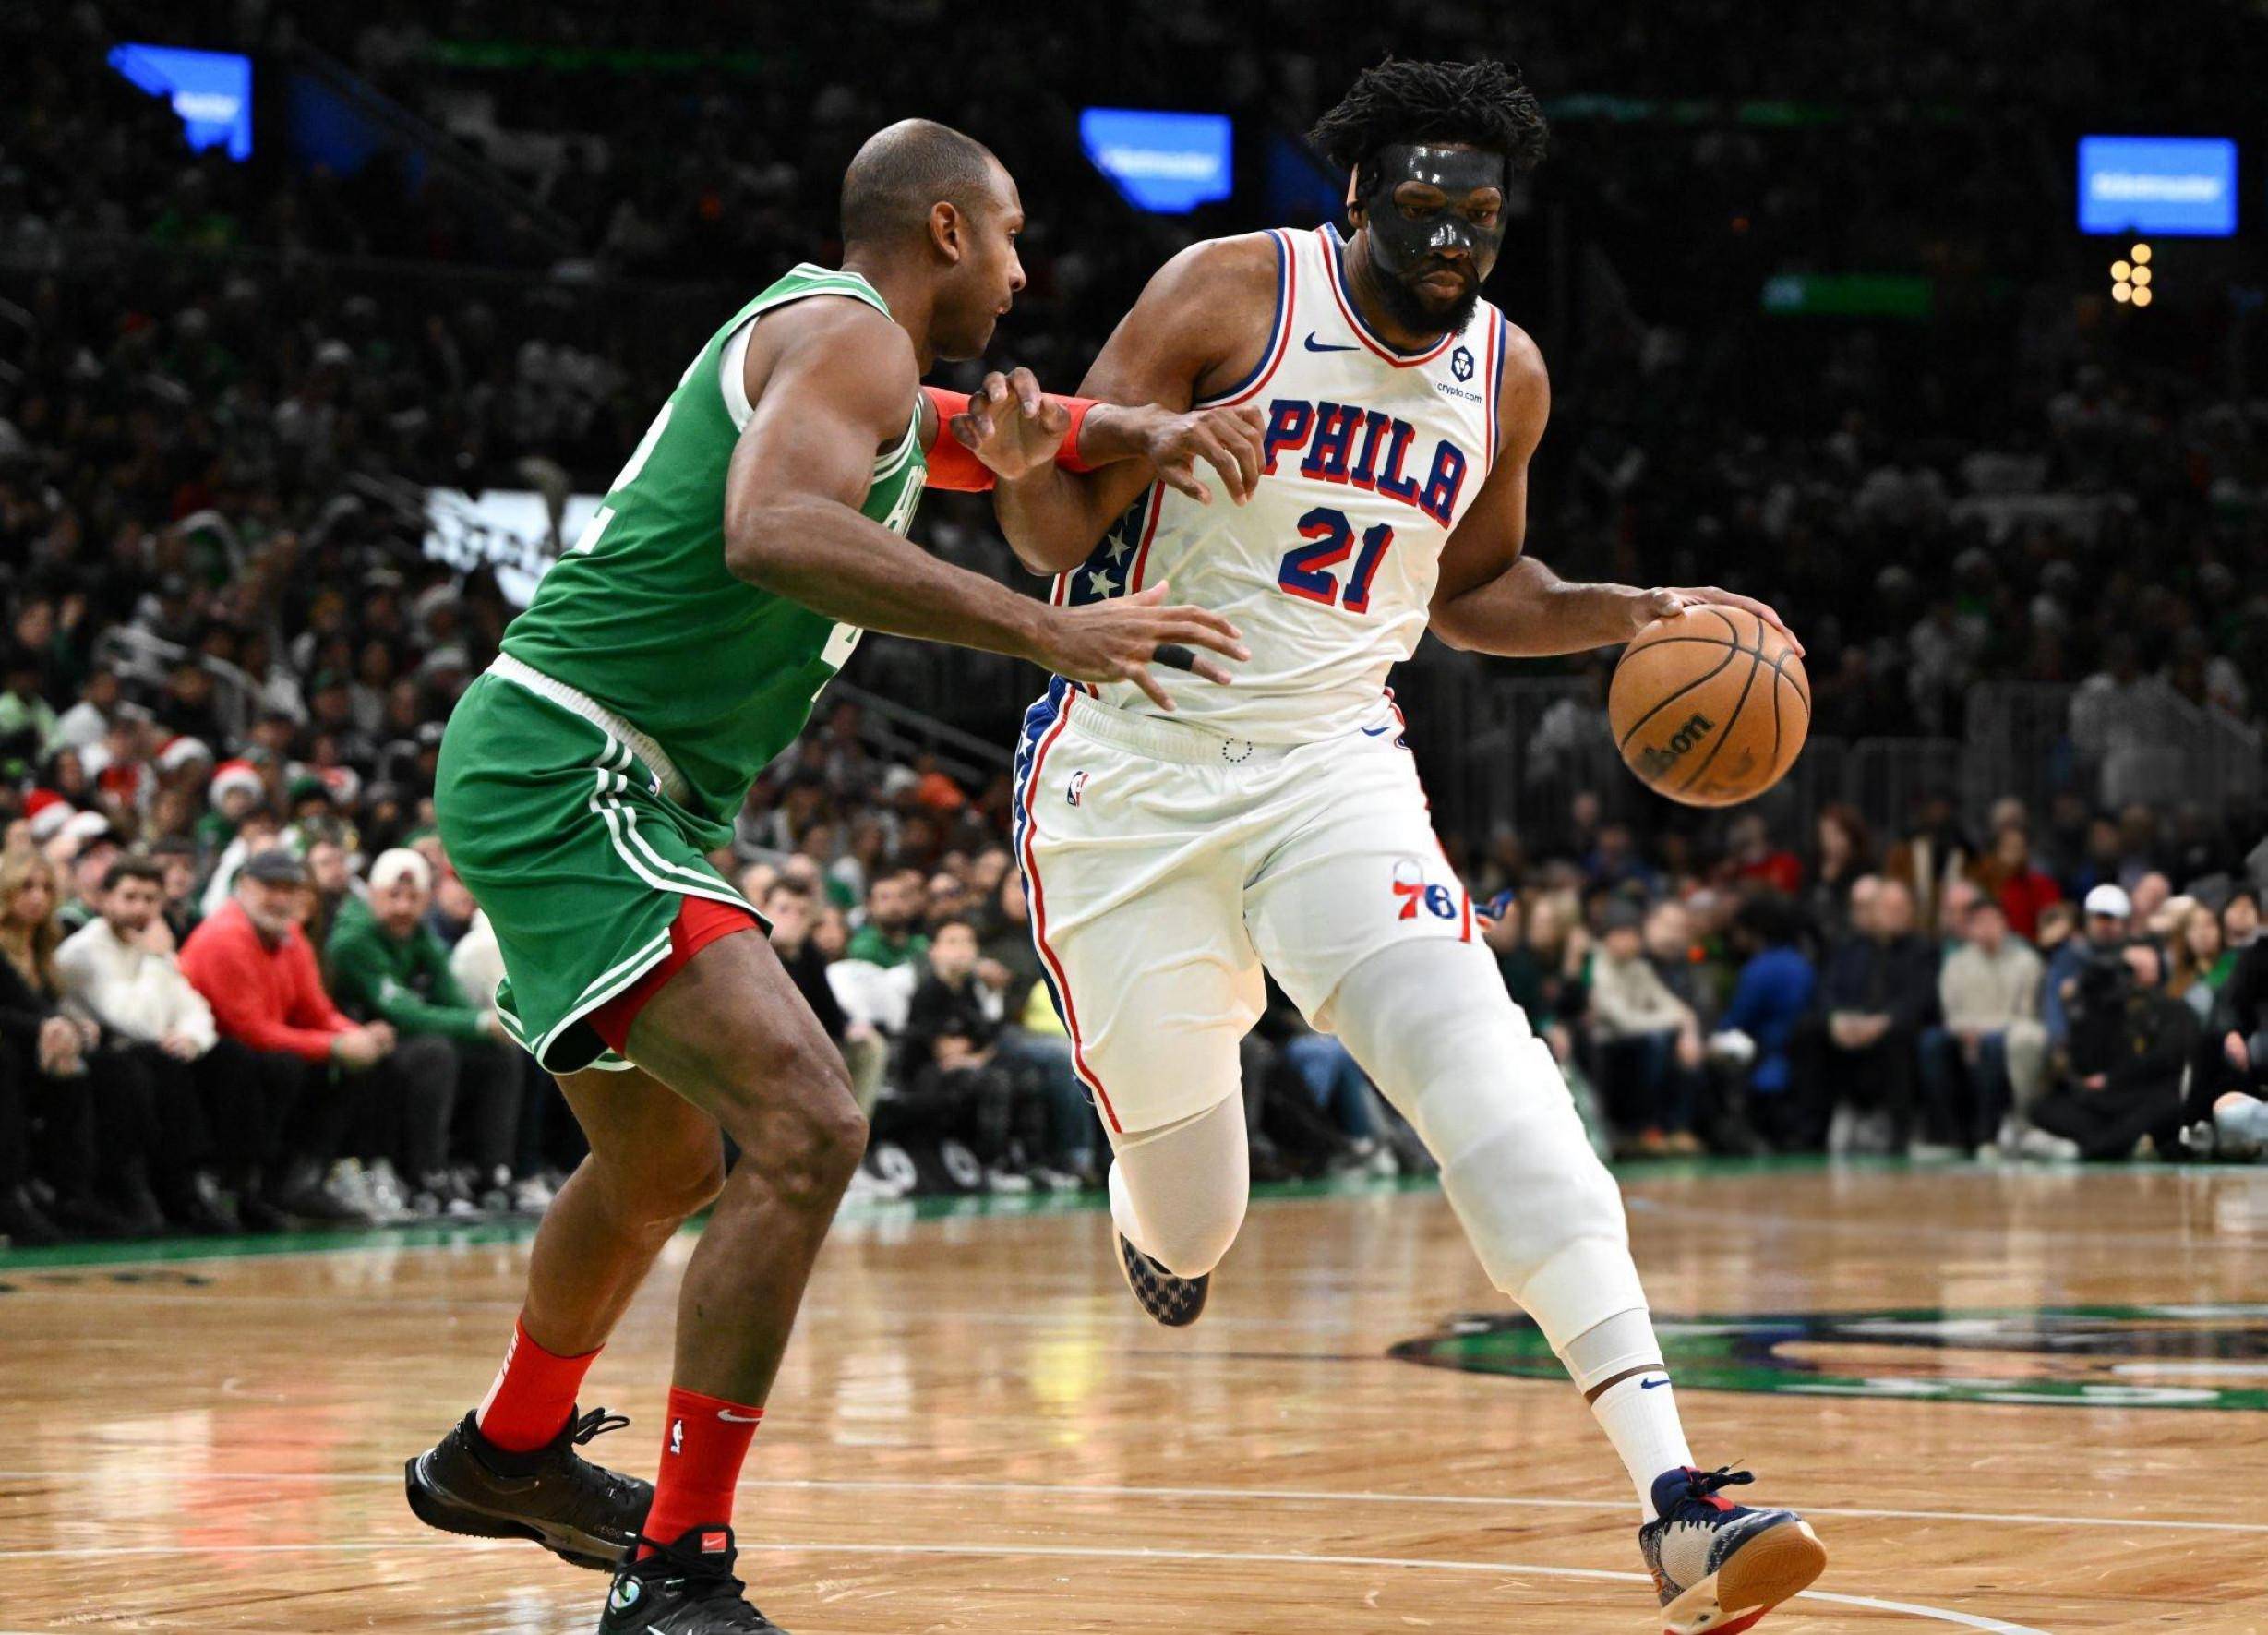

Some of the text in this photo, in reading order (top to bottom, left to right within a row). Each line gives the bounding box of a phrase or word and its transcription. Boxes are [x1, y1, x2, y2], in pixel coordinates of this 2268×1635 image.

[1437, 382, 1482, 403] crypto.com
[1263, 399, 1468, 530] PHILA
[1278, 507, 1394, 614] 21
